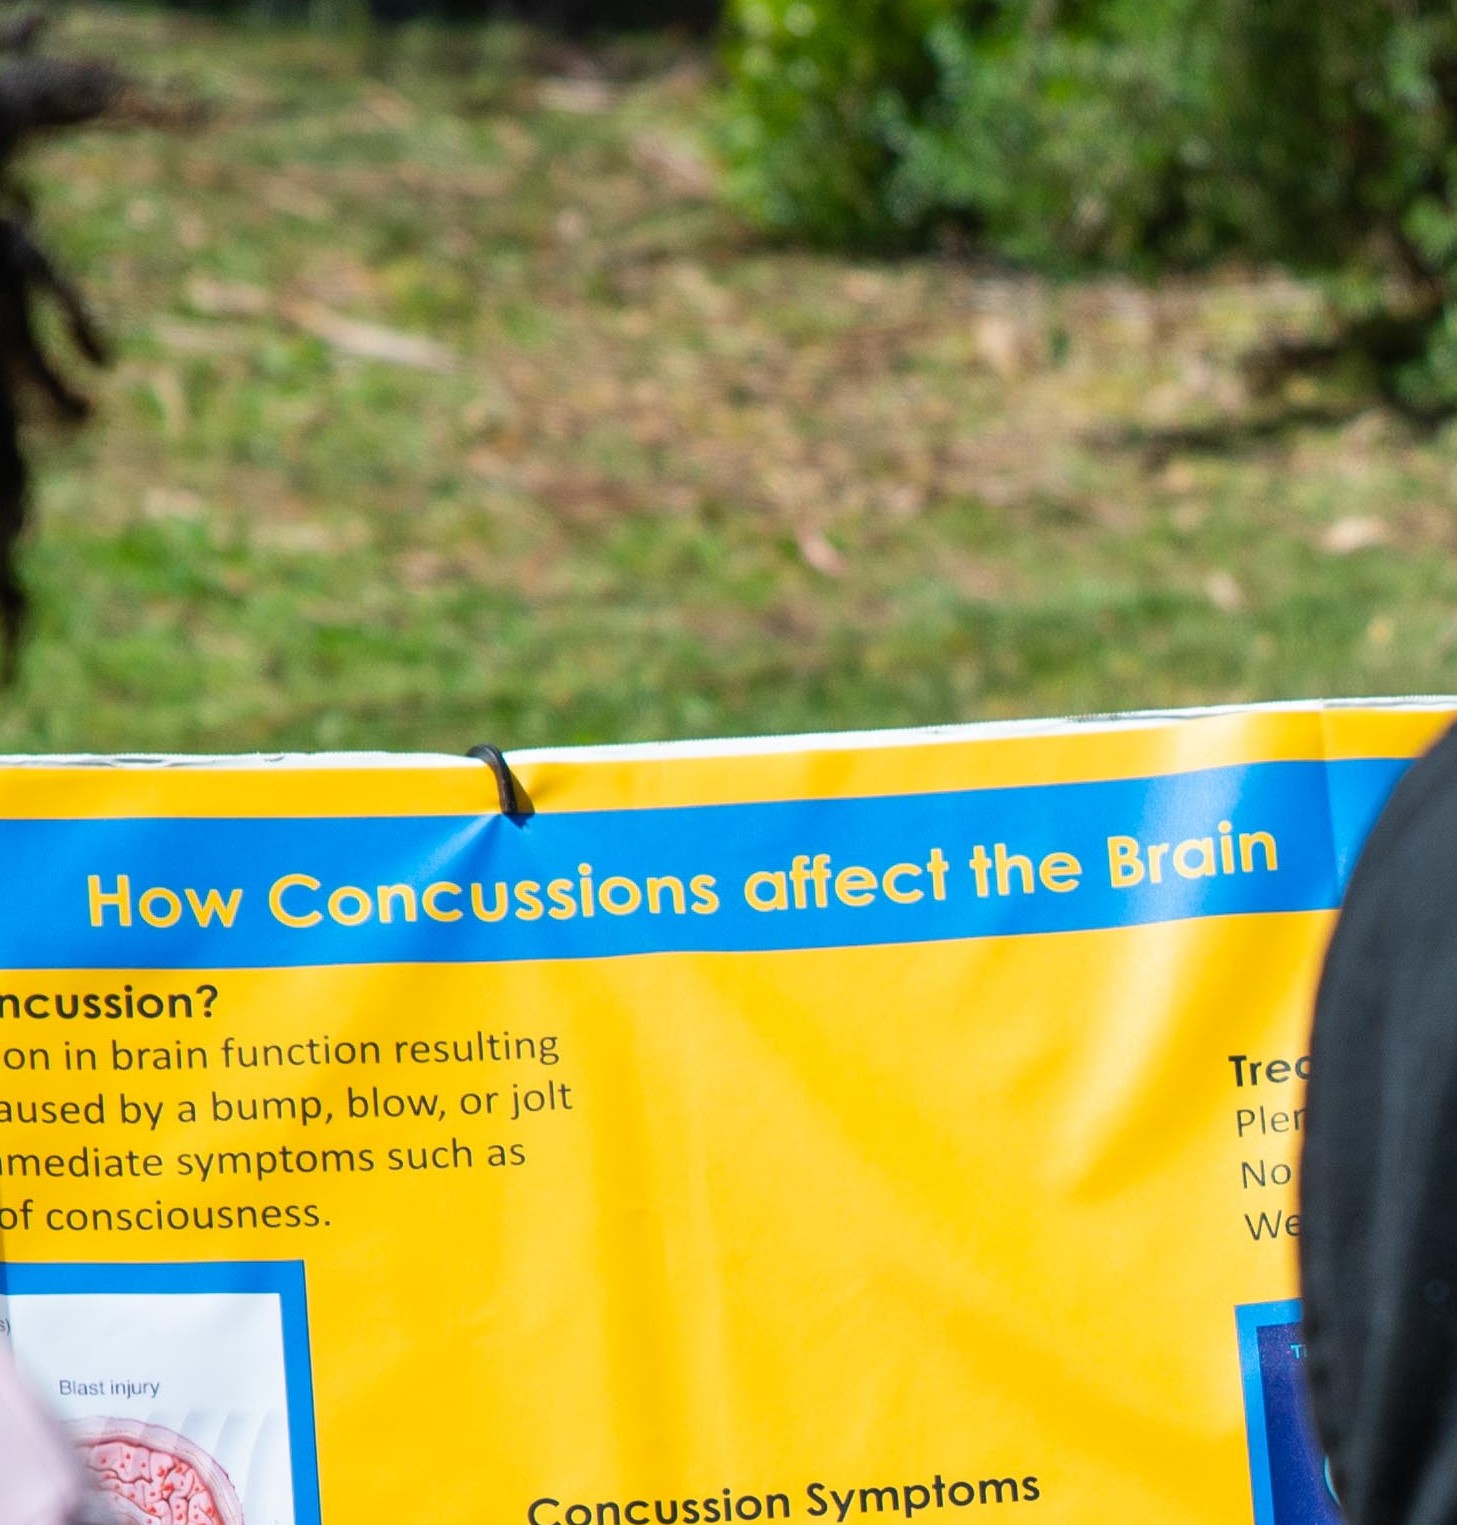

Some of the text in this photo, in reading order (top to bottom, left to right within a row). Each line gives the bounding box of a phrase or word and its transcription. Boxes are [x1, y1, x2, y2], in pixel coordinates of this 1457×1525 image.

[86, 821, 1279, 928] How Concussions affect the Brain
[64, 1040, 96, 1070] in
[112, 1039, 207, 1070] brain
[221, 1035, 380, 1068] function
[395, 1031, 559, 1066] resulting
[120, 1093, 163, 1130] by
[177, 1101, 197, 1123] a
[212, 1091, 333, 1126] bump,
[347, 1086, 446, 1120] blow,
[459, 1091, 498, 1115] or
[509, 1081, 573, 1120] jolt
[0, 1139, 525, 1182] mediate symptoms such as
[1241, 1160, 1291, 1189] No
[46, 1201, 331, 1231] consciousness.
[59, 1380, 160, 1398] Blast injury
[806, 1474, 1041, 1522] Symptoms
